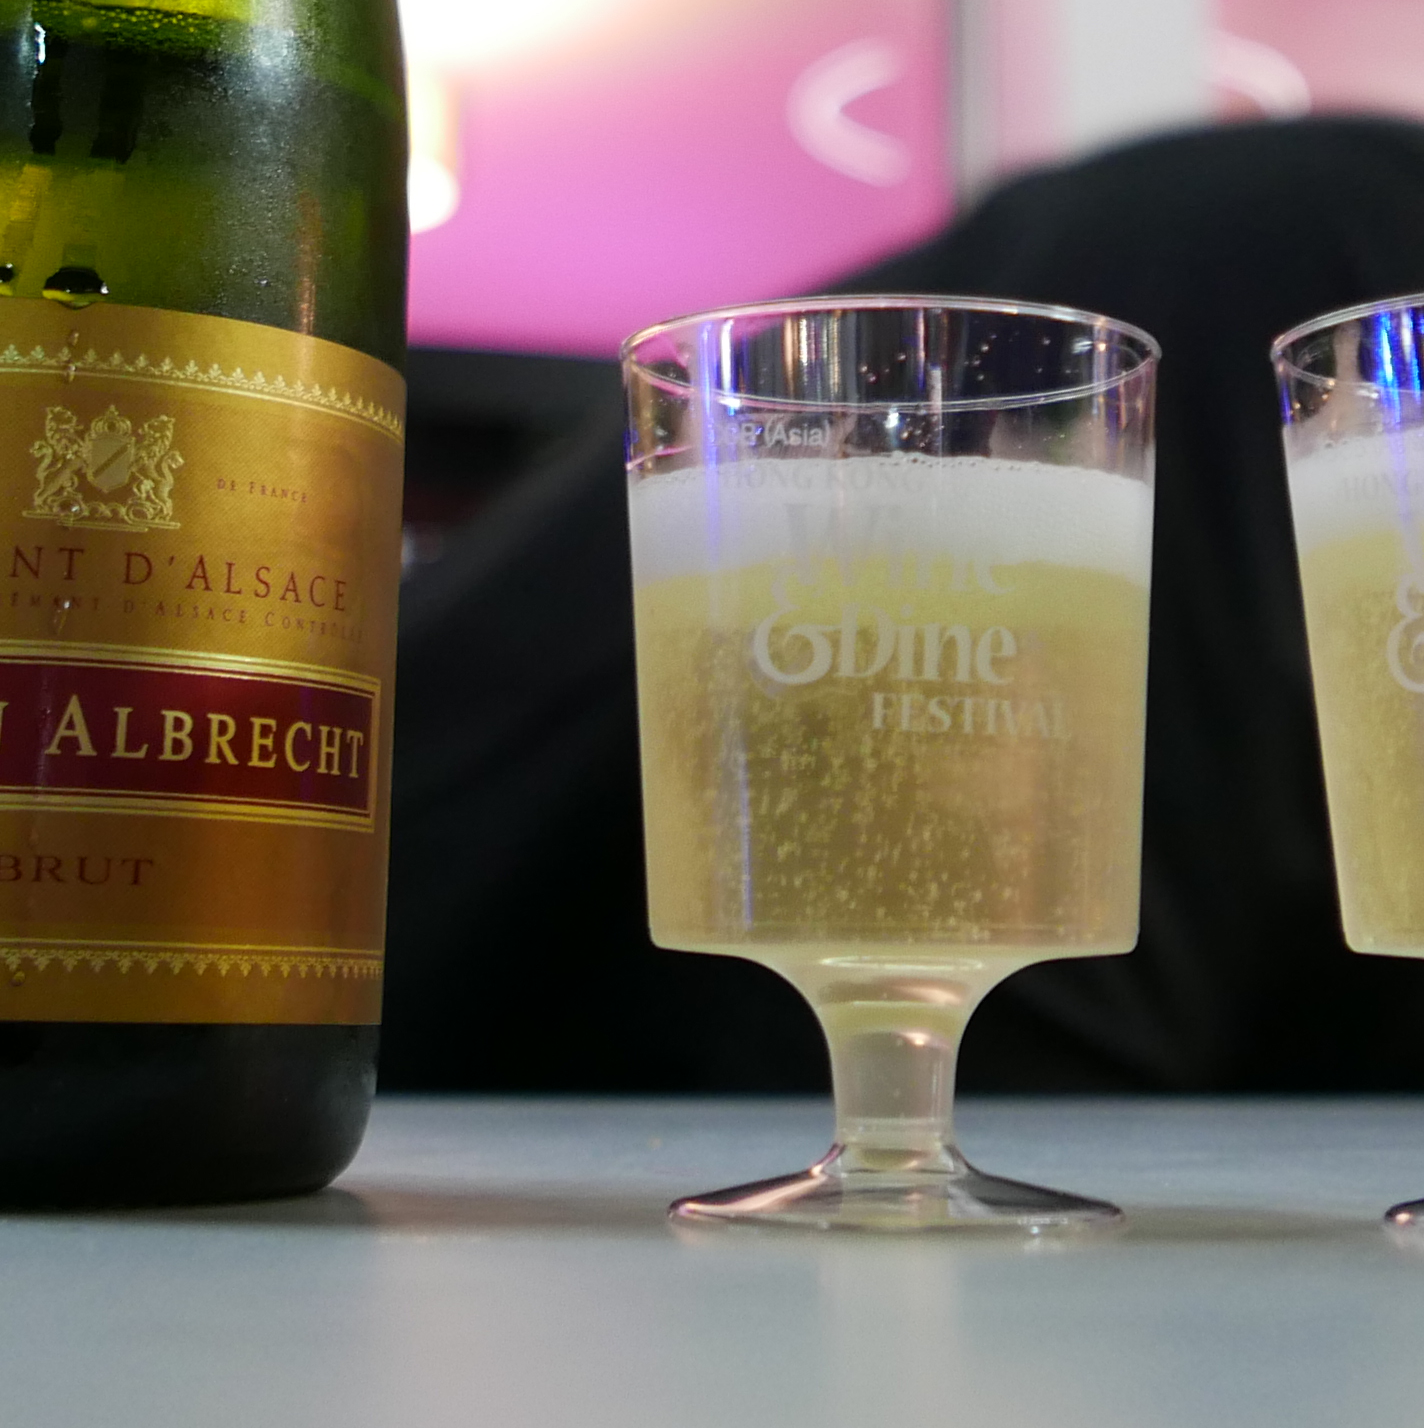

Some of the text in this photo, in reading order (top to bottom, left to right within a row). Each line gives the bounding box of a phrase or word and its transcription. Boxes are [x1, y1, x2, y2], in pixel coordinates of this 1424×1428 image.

[763, 413, 831, 449] (Asia)
[216, 477, 309, 504] DE FRANCE
[121, 550, 348, 613] D'ALSACE
[44, 693, 365, 780] ALBRECHT
[871, 690, 1071, 738] FESTIVAL
